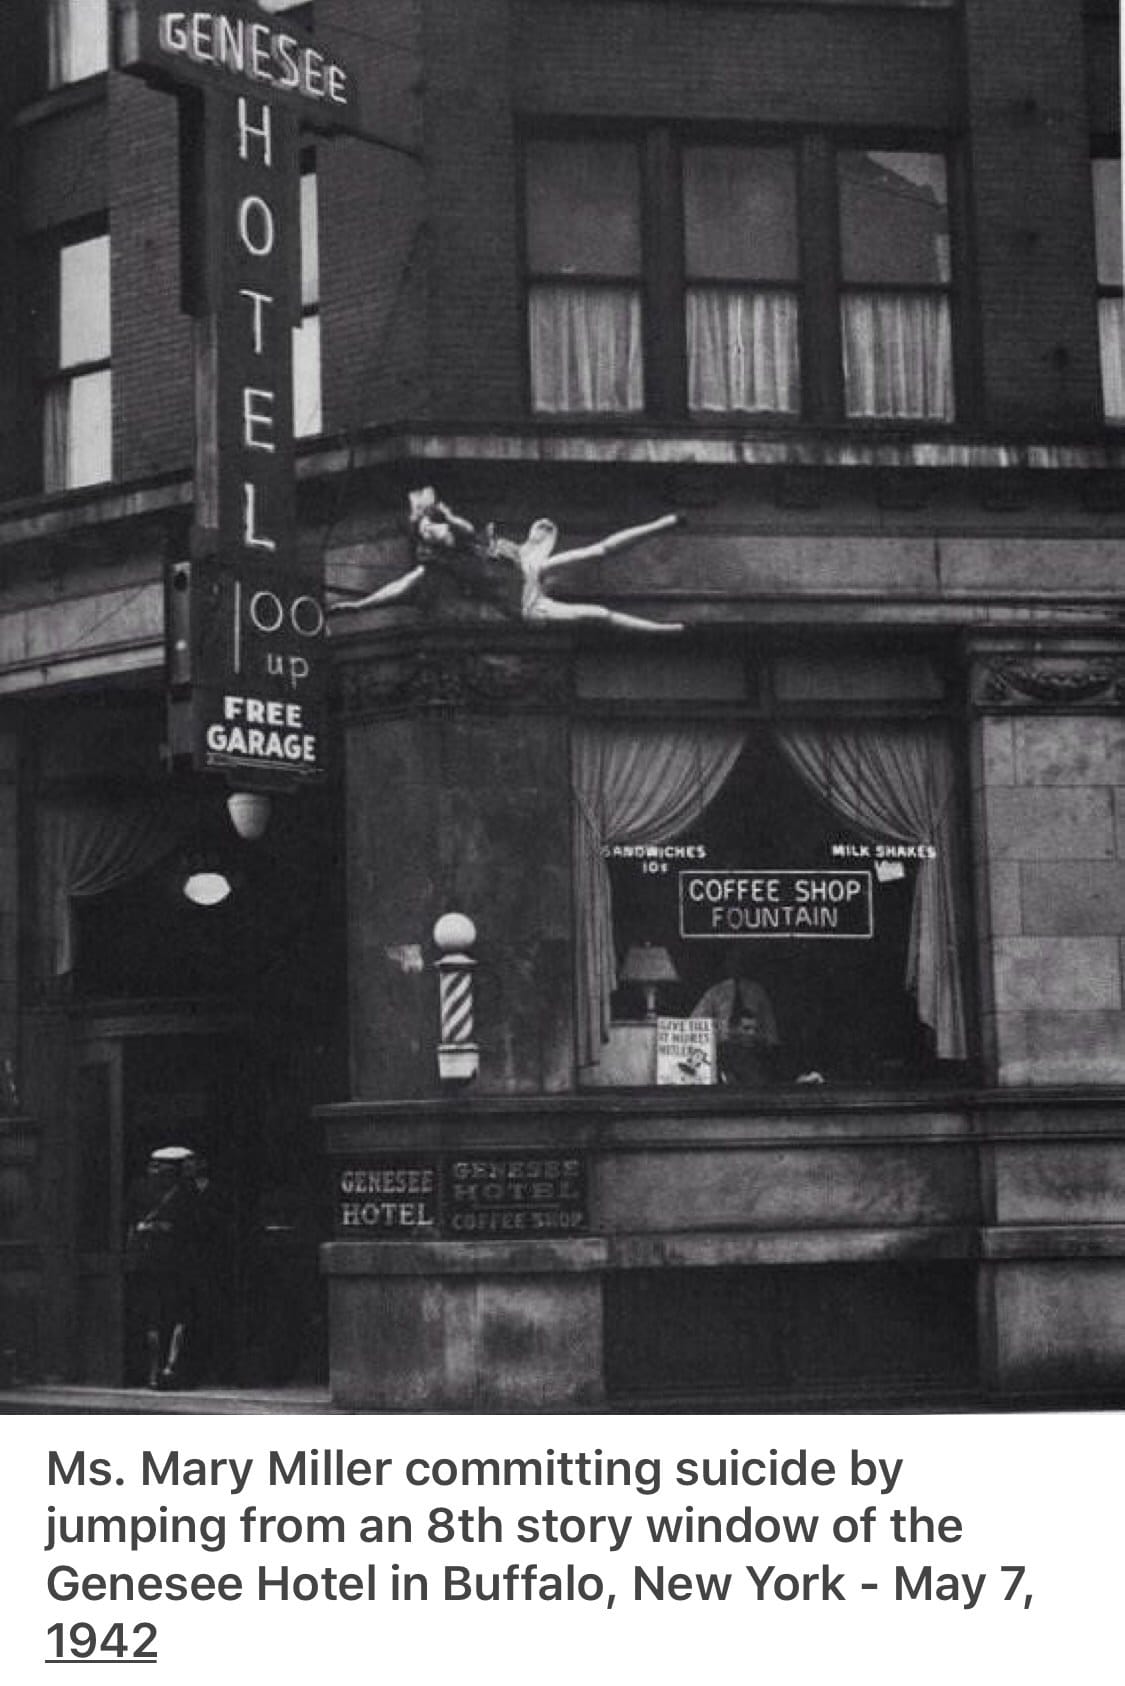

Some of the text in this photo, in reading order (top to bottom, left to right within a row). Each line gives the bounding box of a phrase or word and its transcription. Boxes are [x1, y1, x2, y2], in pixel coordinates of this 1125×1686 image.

[160, 13, 347, 104] GENESEE
[238, 97, 276, 552] HOTEL
[266, 652, 309, 689] up
[223, 695, 302, 728] FREE
[206, 724, 317, 762] GARAGE
[601, 844, 707, 859] SANDWICHES
[831, 844, 937, 860] MILK SHAKES
[688, 878, 862, 902] COFFEE SHOP
[710, 905, 839, 929] FOUNTAIN
[341, 1169, 435, 1194] GENESEE
[453, 1181, 580, 1200] HOTEL
[341, 1201, 434, 1226] HOTEL
